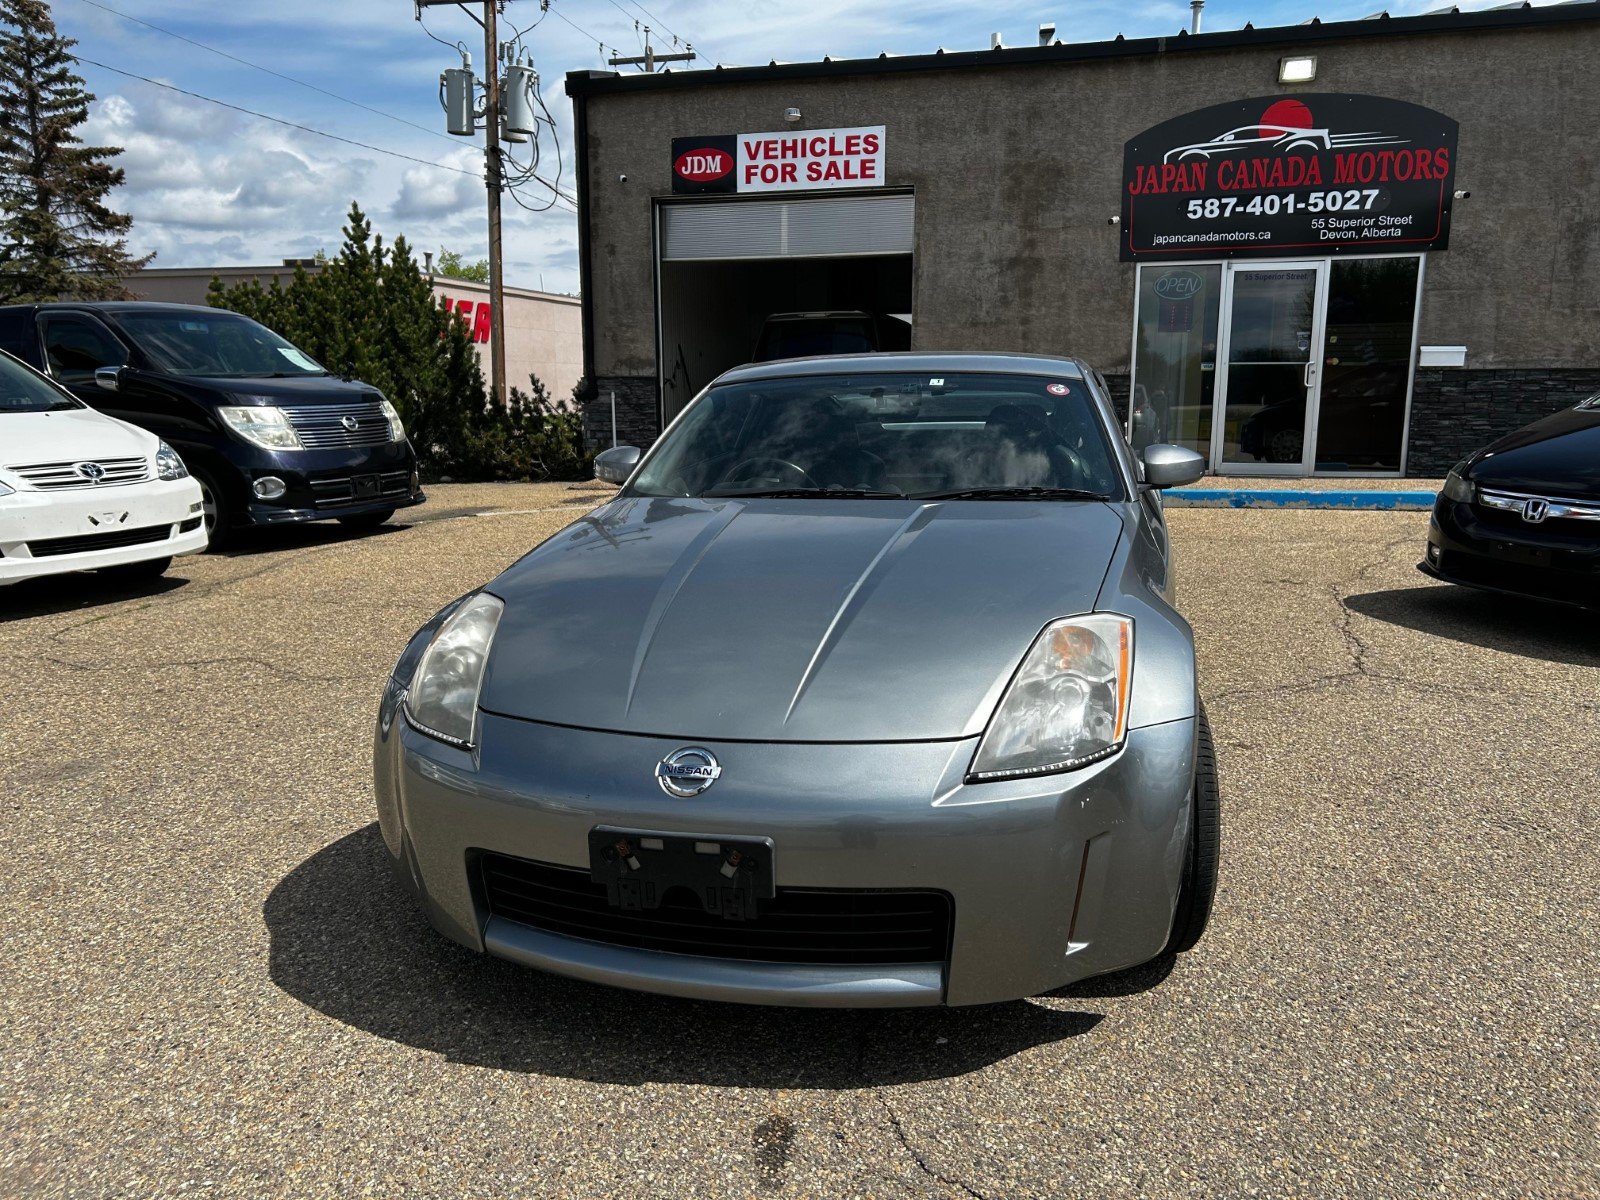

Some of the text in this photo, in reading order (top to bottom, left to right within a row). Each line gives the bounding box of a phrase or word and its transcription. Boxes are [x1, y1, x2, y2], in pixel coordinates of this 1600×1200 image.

[744, 134, 879, 160] VEHICLES
[682, 155, 722, 174] JDM
[745, 159, 876, 184] FOR SALE
[1129, 147, 1449, 195] JAPAN CANADA MOTORS
[1187, 189, 1379, 220] 587-401-5027
[1311, 214, 1413, 230] 55 Superior Street
[1153, 230, 1271, 246] japancanadamotors.ca
[1320, 227, 1402, 240] Devon, Alberta
[1156, 277, 1199, 292] OPEN
[1254, 272, 1285, 282] Superior
[664, 765, 712, 776] NISSAN
